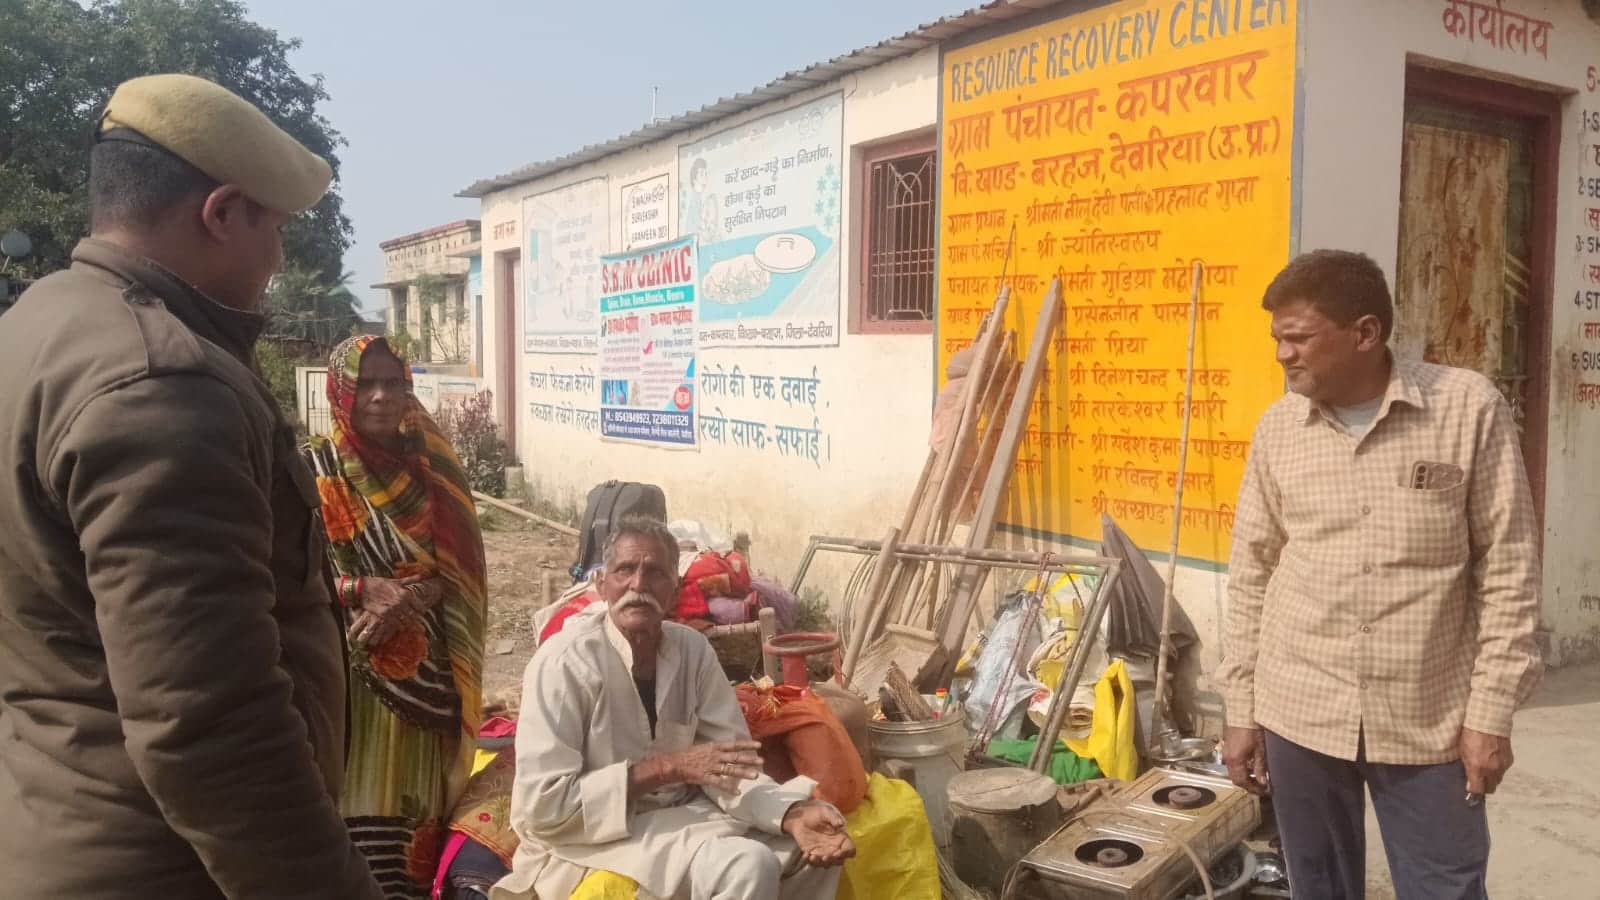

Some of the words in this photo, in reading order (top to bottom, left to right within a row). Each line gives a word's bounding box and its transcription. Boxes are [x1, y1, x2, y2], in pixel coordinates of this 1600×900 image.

[951, 42, 1039, 103] RESOURCE
[1046, 8, 1161, 80] RECOVERY
[1169, 0, 1288, 49] CENTER
[948, 110, 995, 160] ग्राम
[1116, 50, 1270, 123] कपरवार
[637, 244, 692, 289] CLINIC
[750, 374, 776, 400] एक
